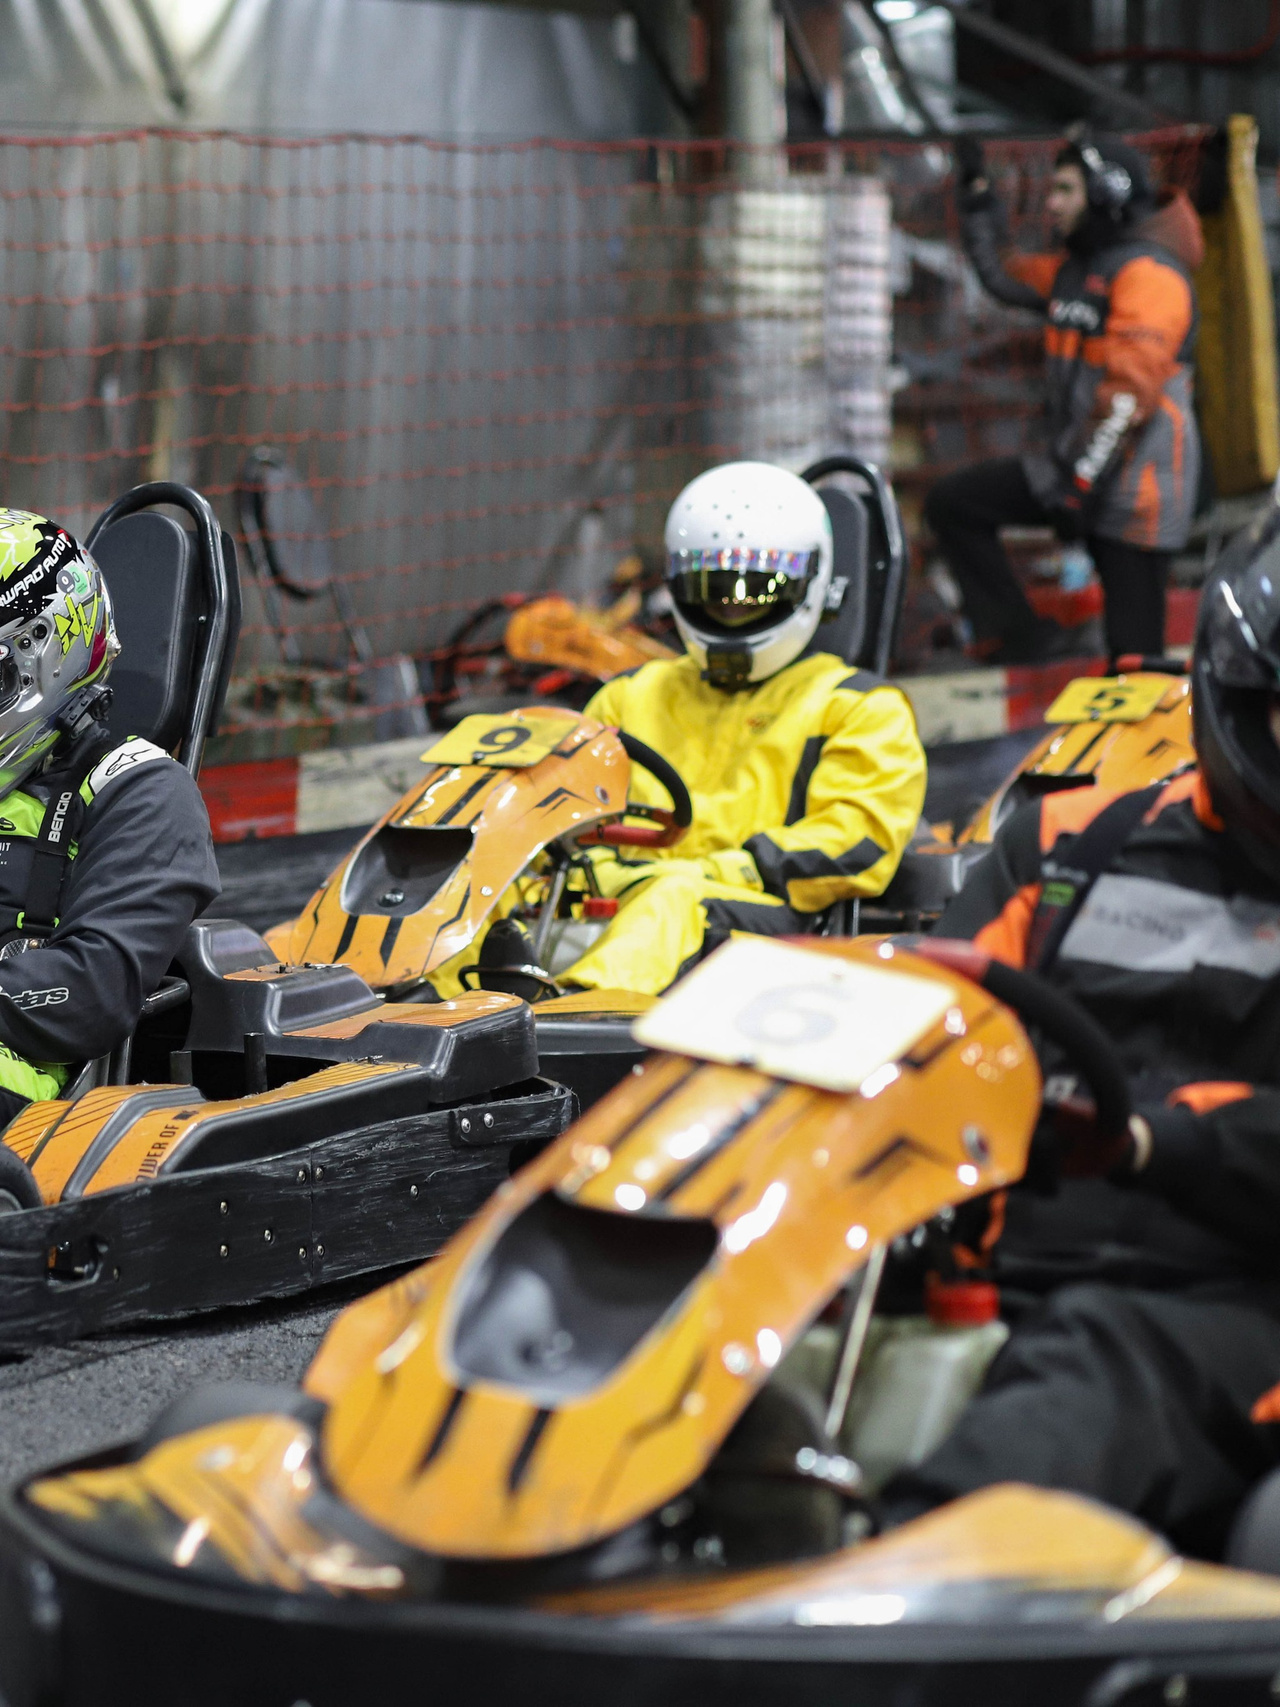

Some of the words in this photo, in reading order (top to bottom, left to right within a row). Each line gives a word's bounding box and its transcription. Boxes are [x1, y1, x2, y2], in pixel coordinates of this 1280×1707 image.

[42, 538, 66, 573] AUTO
[1083, 686, 1136, 711] 5
[474, 726, 532, 756] 9
[47, 791, 73, 843] BENGIO
[733, 982, 858, 1048] 6
[159, 1124, 180, 1138] OF
